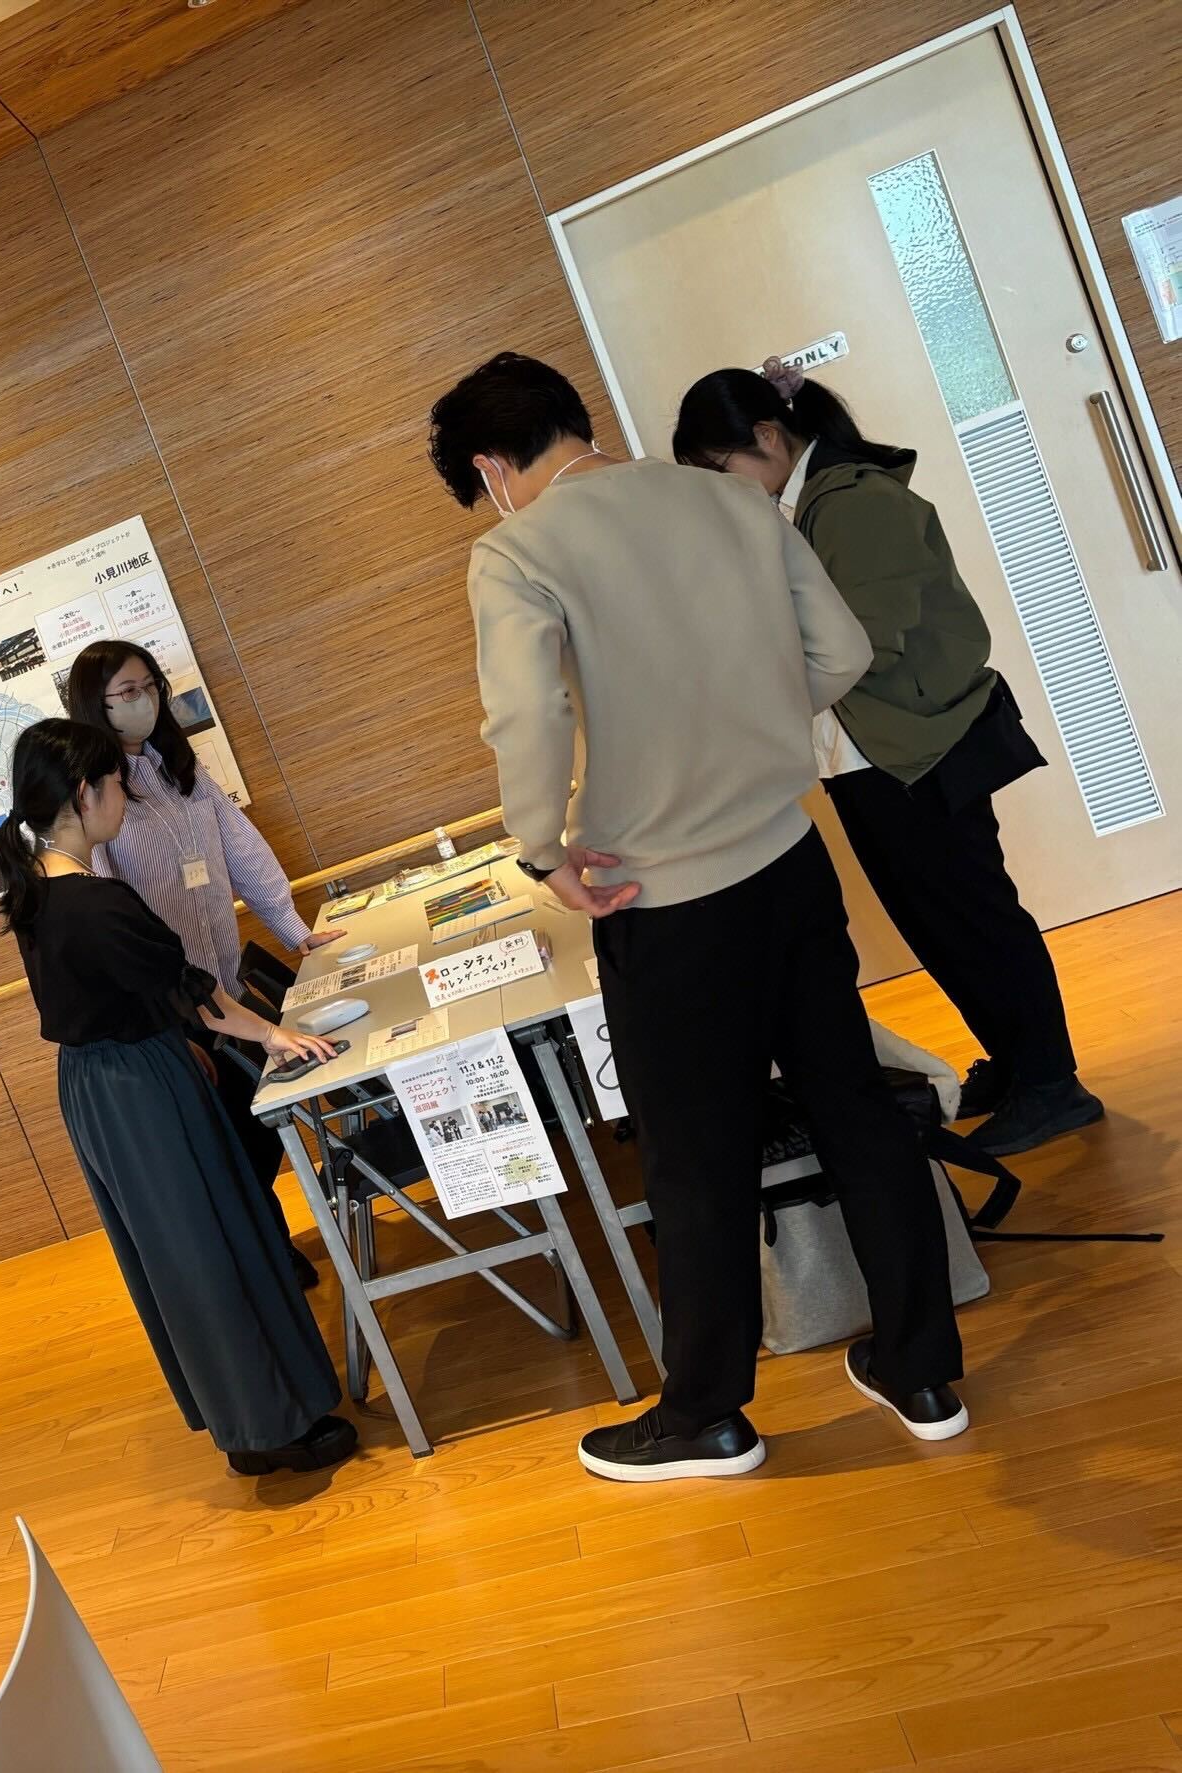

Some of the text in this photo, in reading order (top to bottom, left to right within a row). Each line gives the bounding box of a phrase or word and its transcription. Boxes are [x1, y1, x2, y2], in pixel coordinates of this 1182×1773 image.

[92, 551, 152, 586] 小見川地区
[423, 950, 495, 984] スローシティ
[458, 1053, 505, 1075] 11.1 & 11.2
[404, 1073, 453, 1095] スローシティ
[464, 1074, 485, 1087] 10:00
[408, 1082, 458, 1104] プロジェクト
